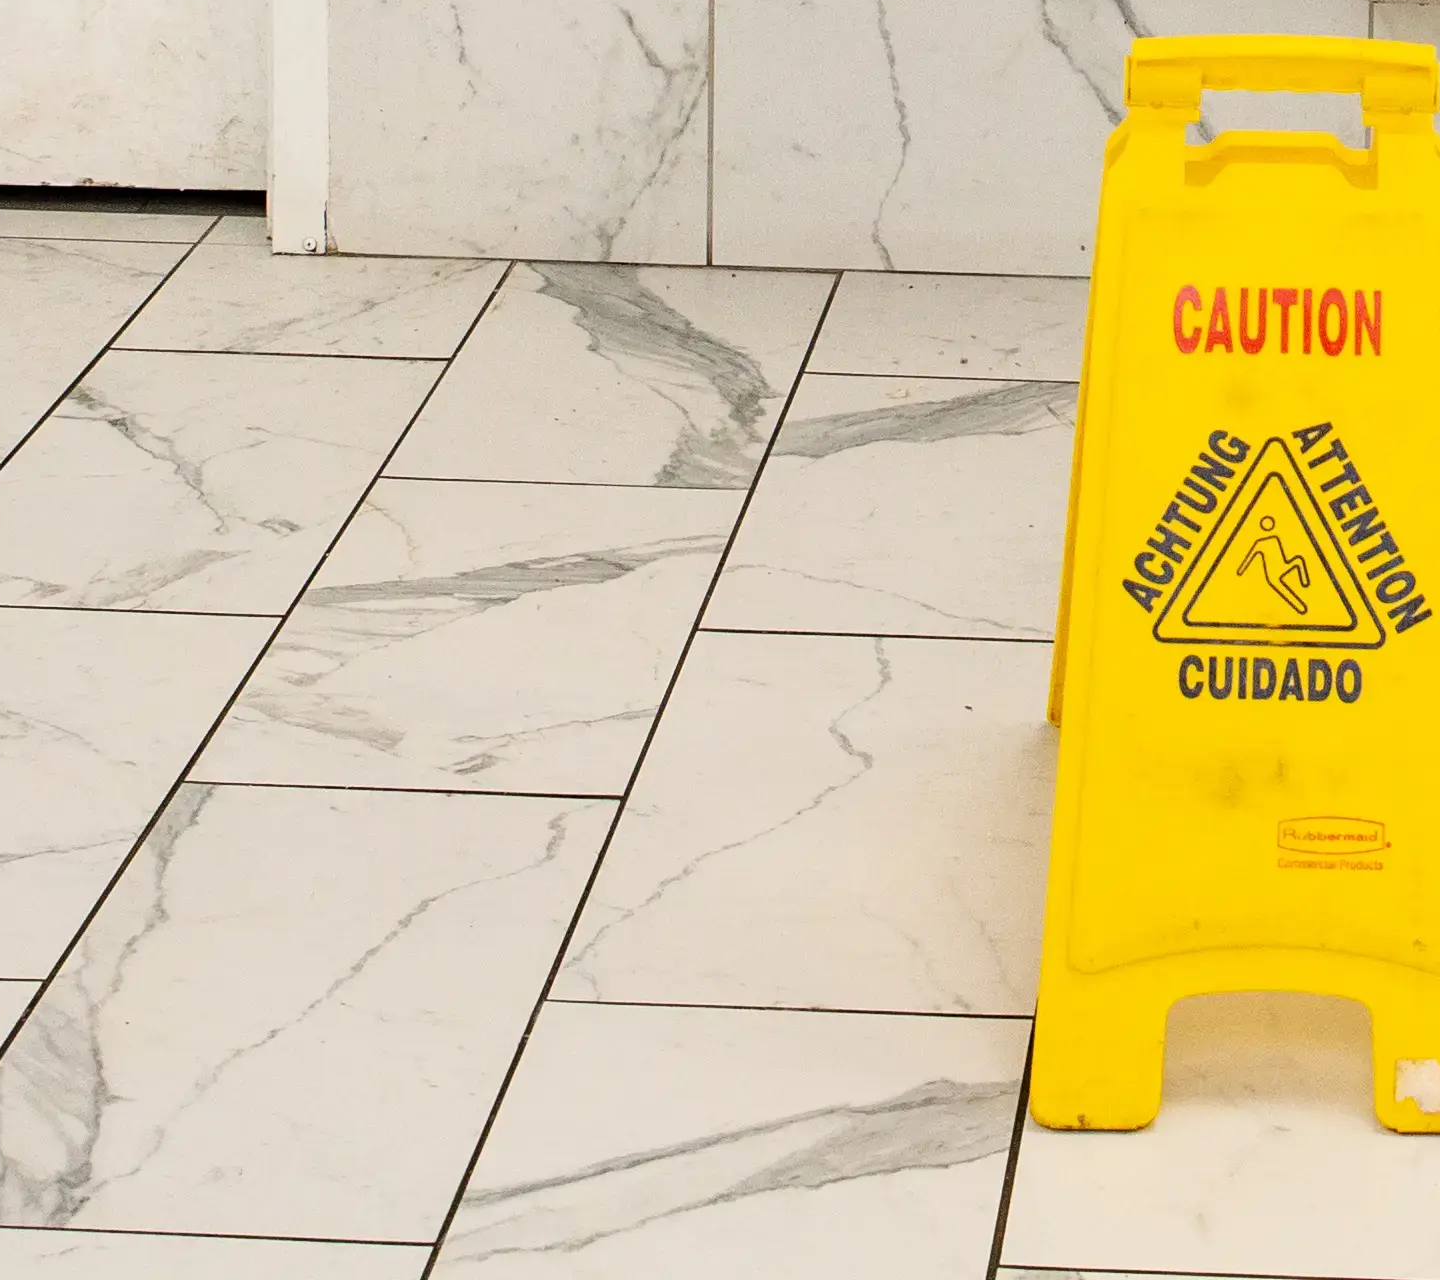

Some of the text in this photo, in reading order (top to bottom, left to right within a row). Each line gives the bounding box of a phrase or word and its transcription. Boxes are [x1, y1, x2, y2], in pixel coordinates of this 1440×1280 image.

[1173, 285, 1382, 357] CAUTION
[1122, 429, 1251, 614] ACHTUNG
[1291, 421, 1433, 634] ATTENTION
[1178, 654, 1362, 704] CUIDADO
